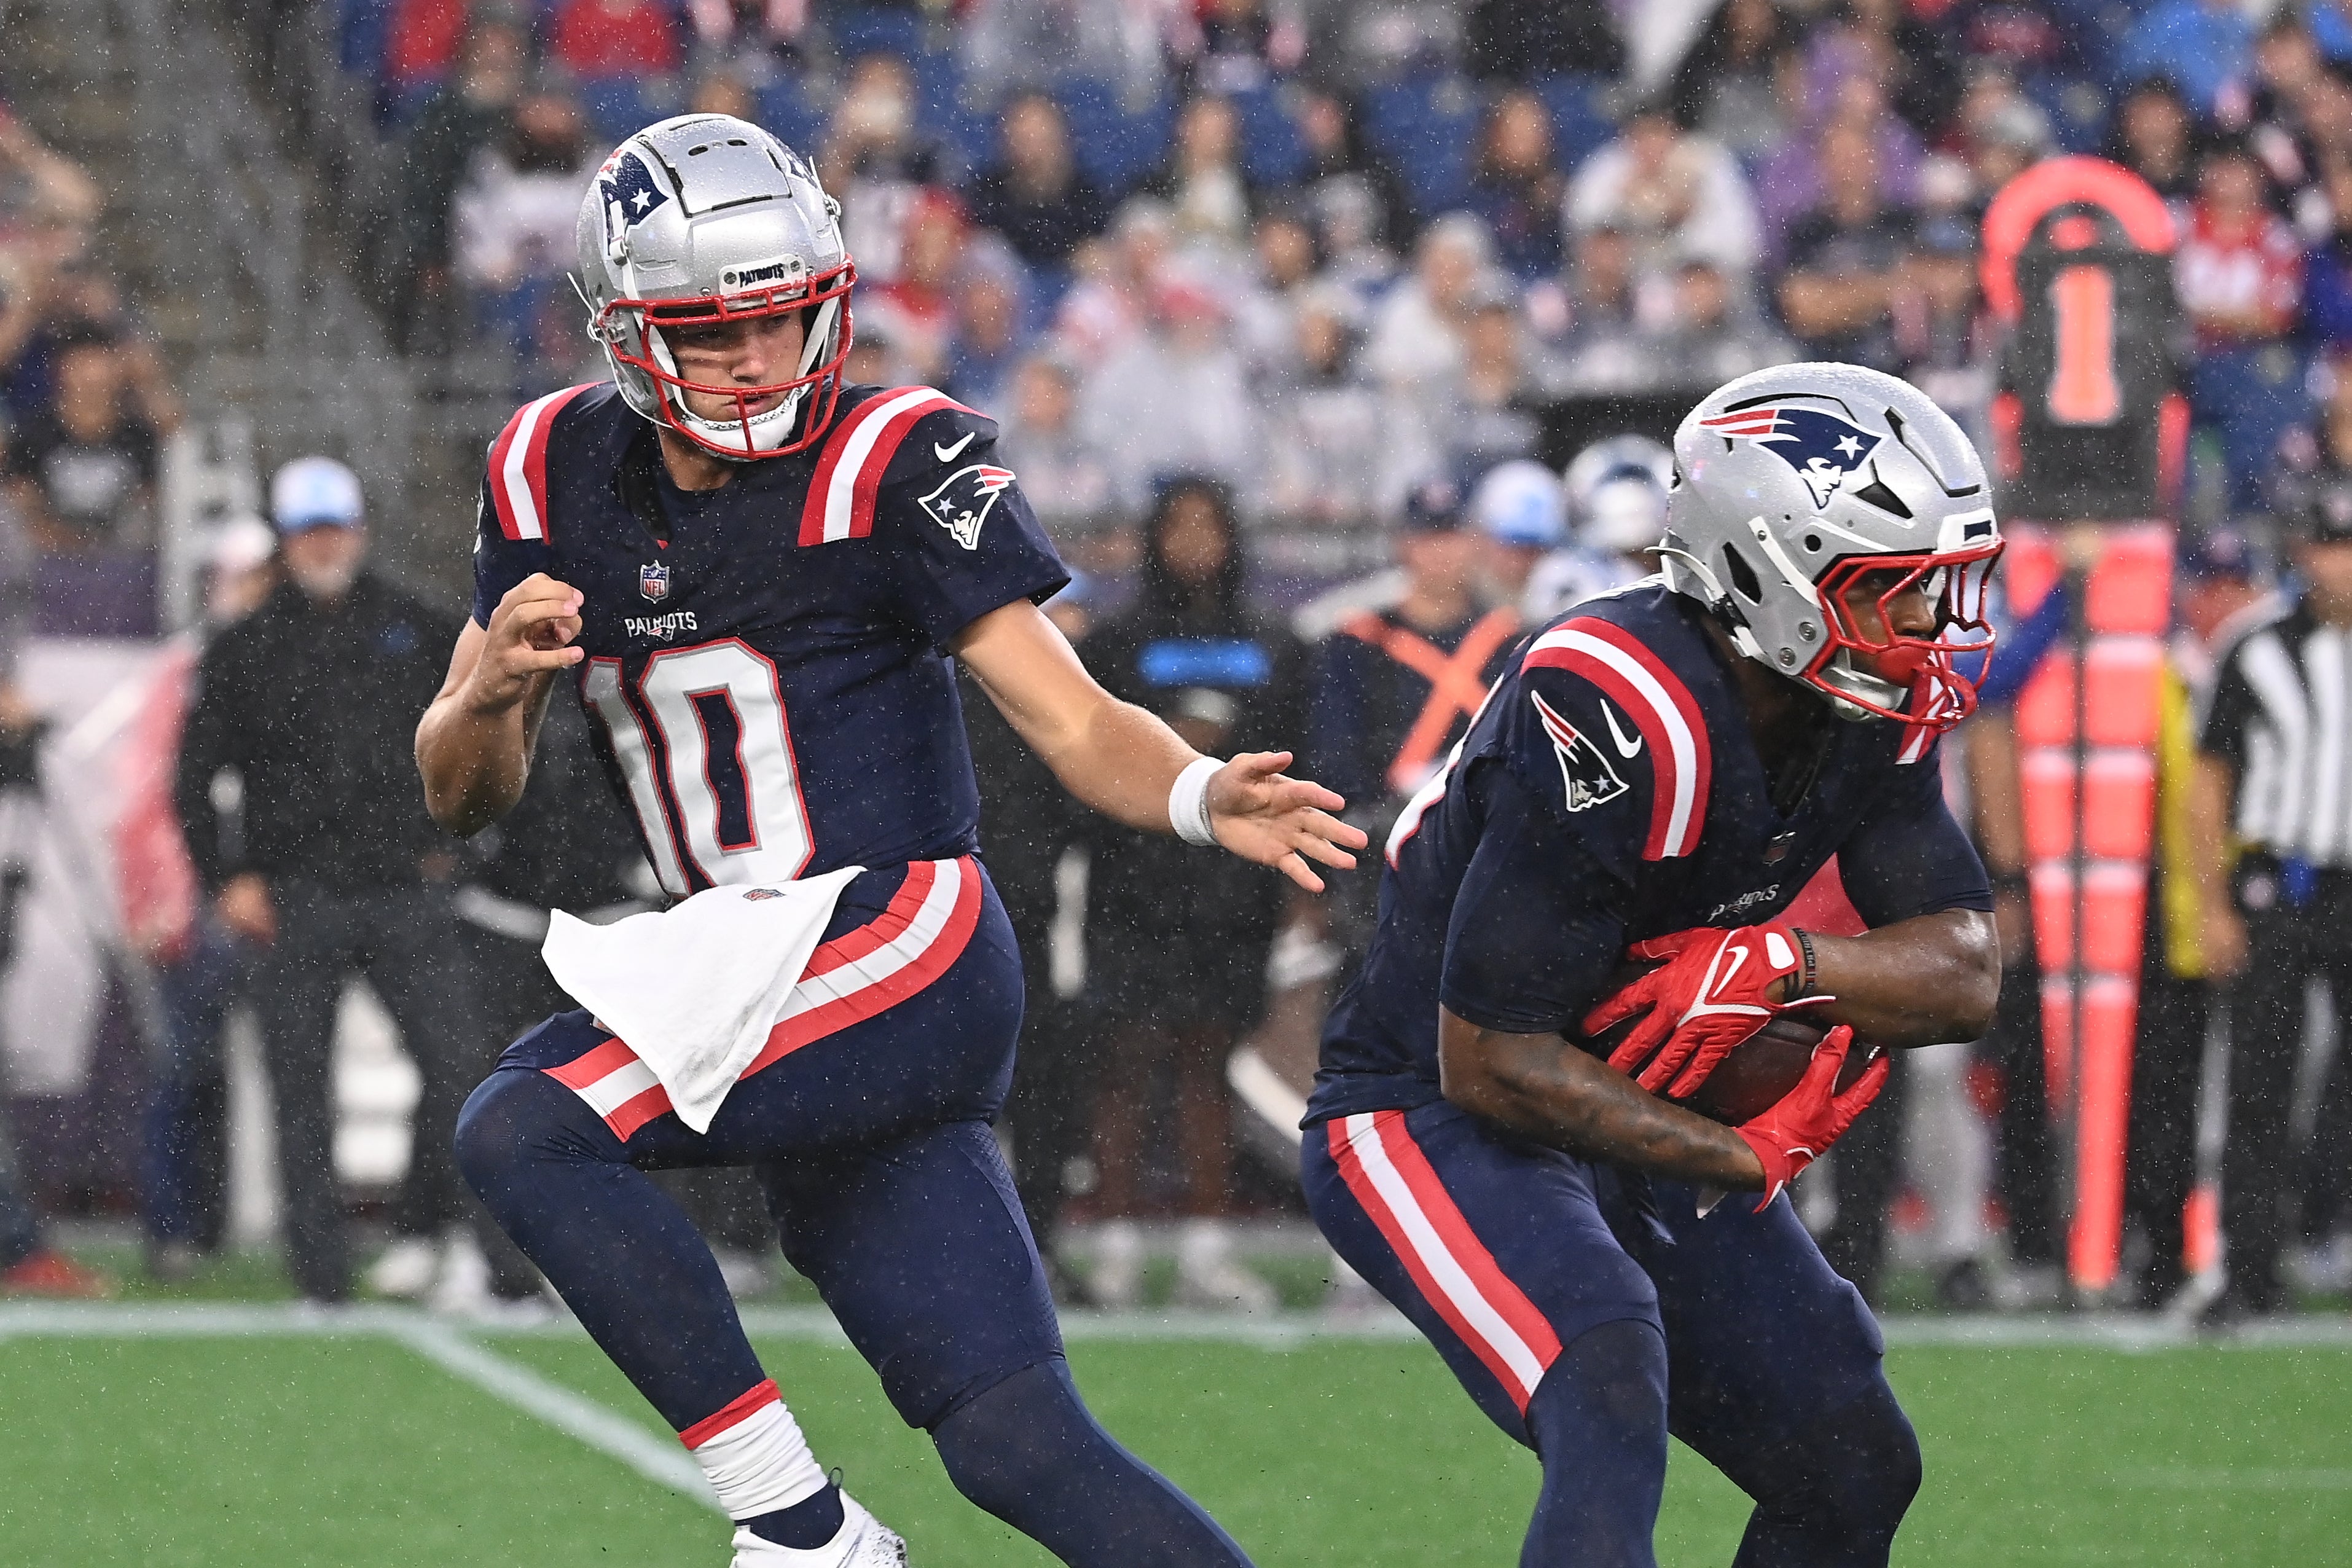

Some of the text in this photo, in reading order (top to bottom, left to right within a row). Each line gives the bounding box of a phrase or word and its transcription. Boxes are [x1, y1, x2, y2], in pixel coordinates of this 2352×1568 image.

[738, 262, 785, 288] PATRIOTS
[2047, 264, 2122, 425] 1
[645, 580, 665, 597] NFL
[624, 611, 699, 638] PATRIOTS
[582, 637, 817, 901] 10
